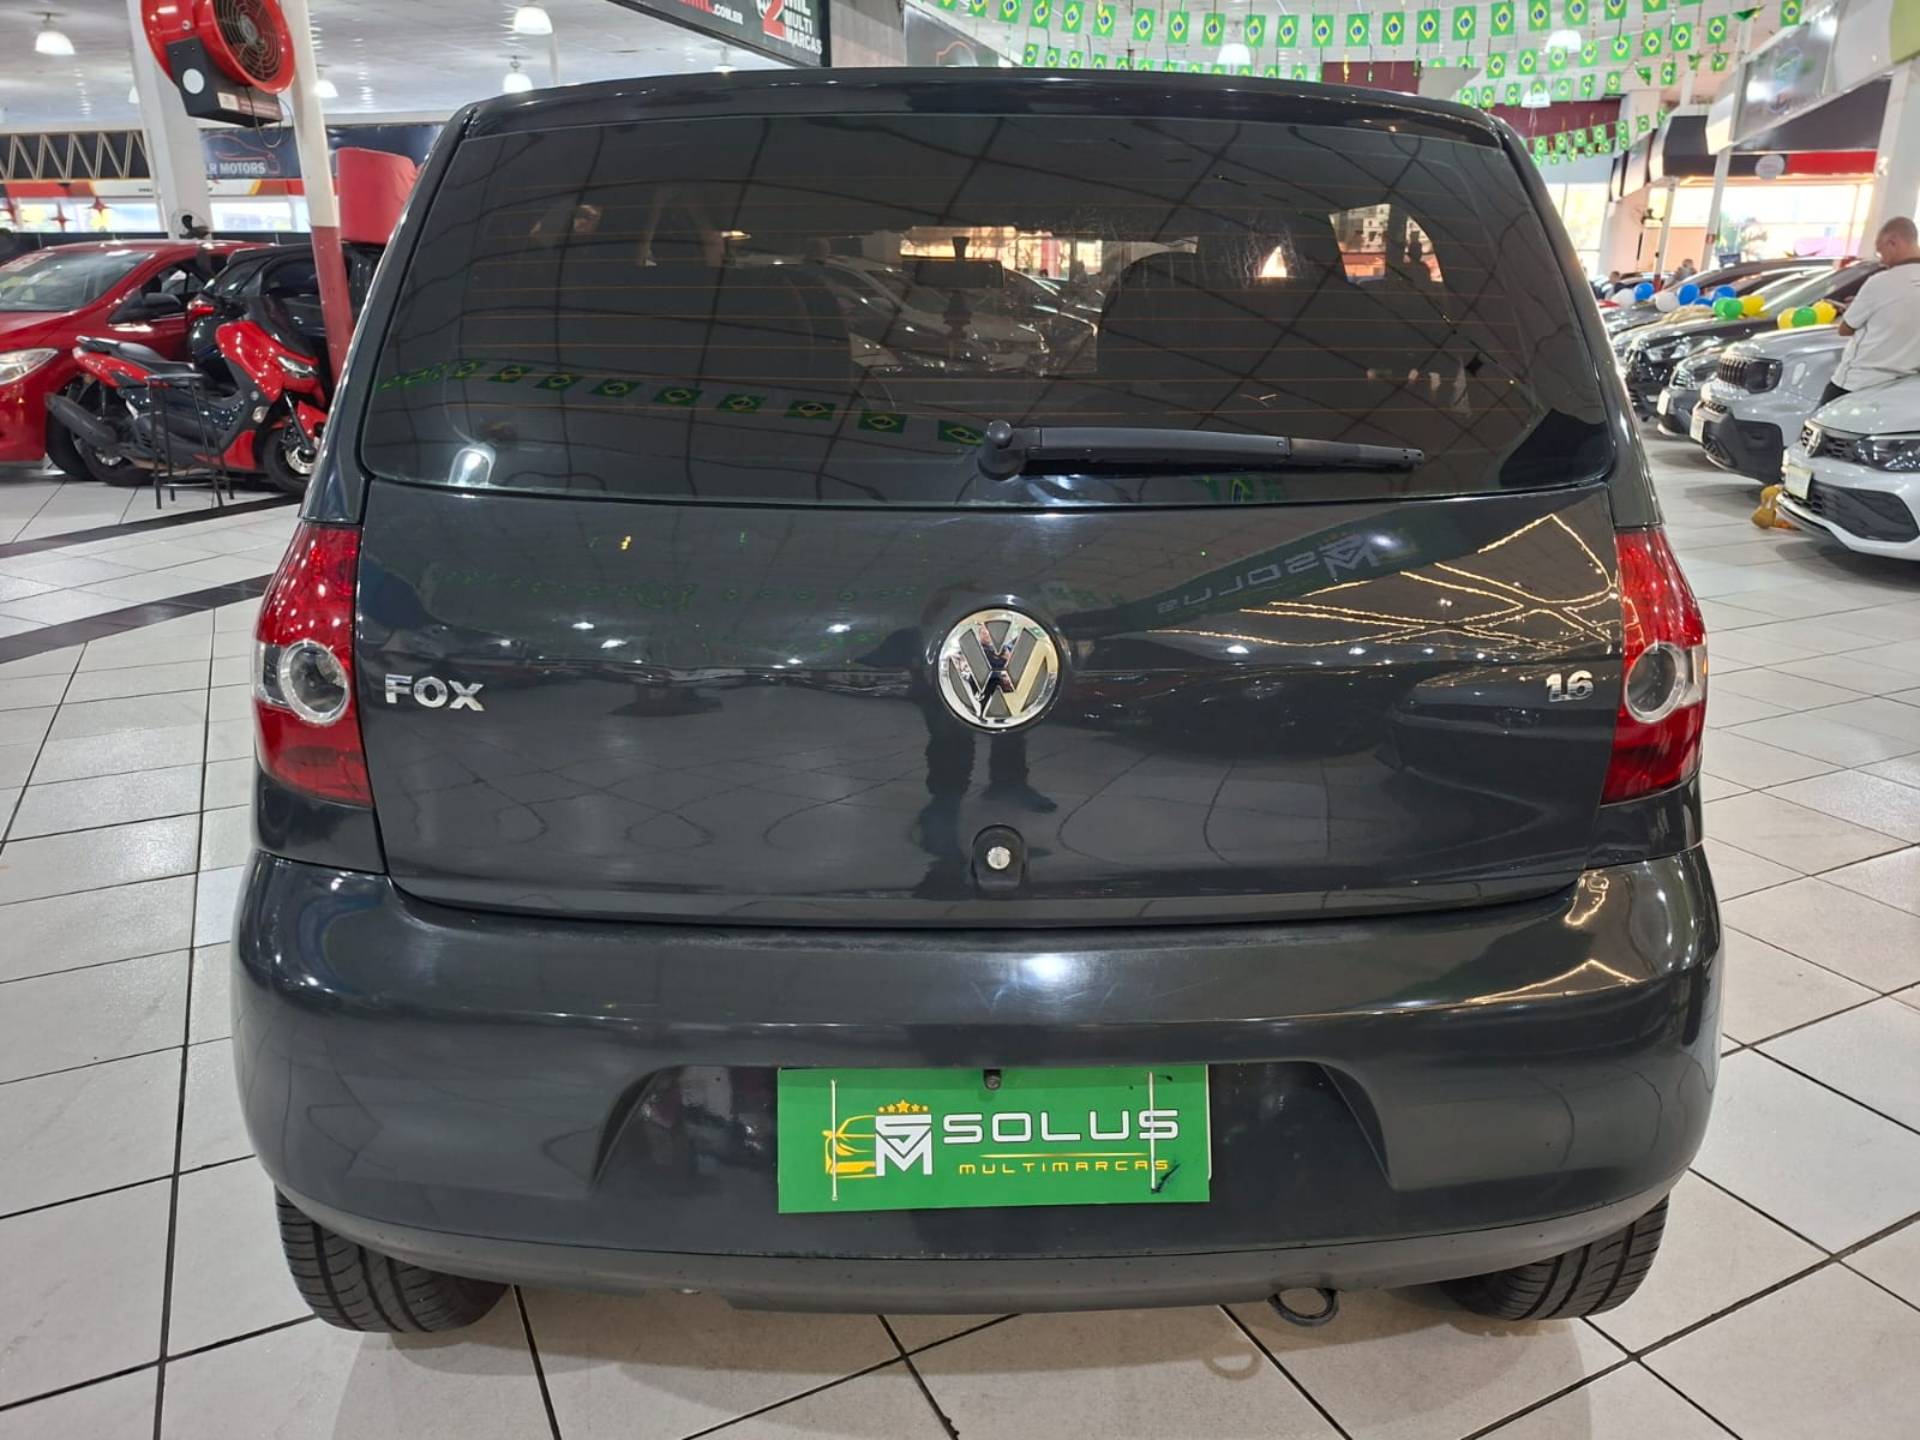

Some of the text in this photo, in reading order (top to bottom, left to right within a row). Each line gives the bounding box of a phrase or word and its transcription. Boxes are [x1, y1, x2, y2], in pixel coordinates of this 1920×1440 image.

[784, 10, 813, 35] MULTI
[784, 26, 822, 55] MARCAS
[220, 162, 266, 175] MOTORS
[385, 673, 485, 711] FOX
[942, 1109, 1180, 1144] SOLUS
[958, 1159, 1170, 1176] MULTIMARCAS
